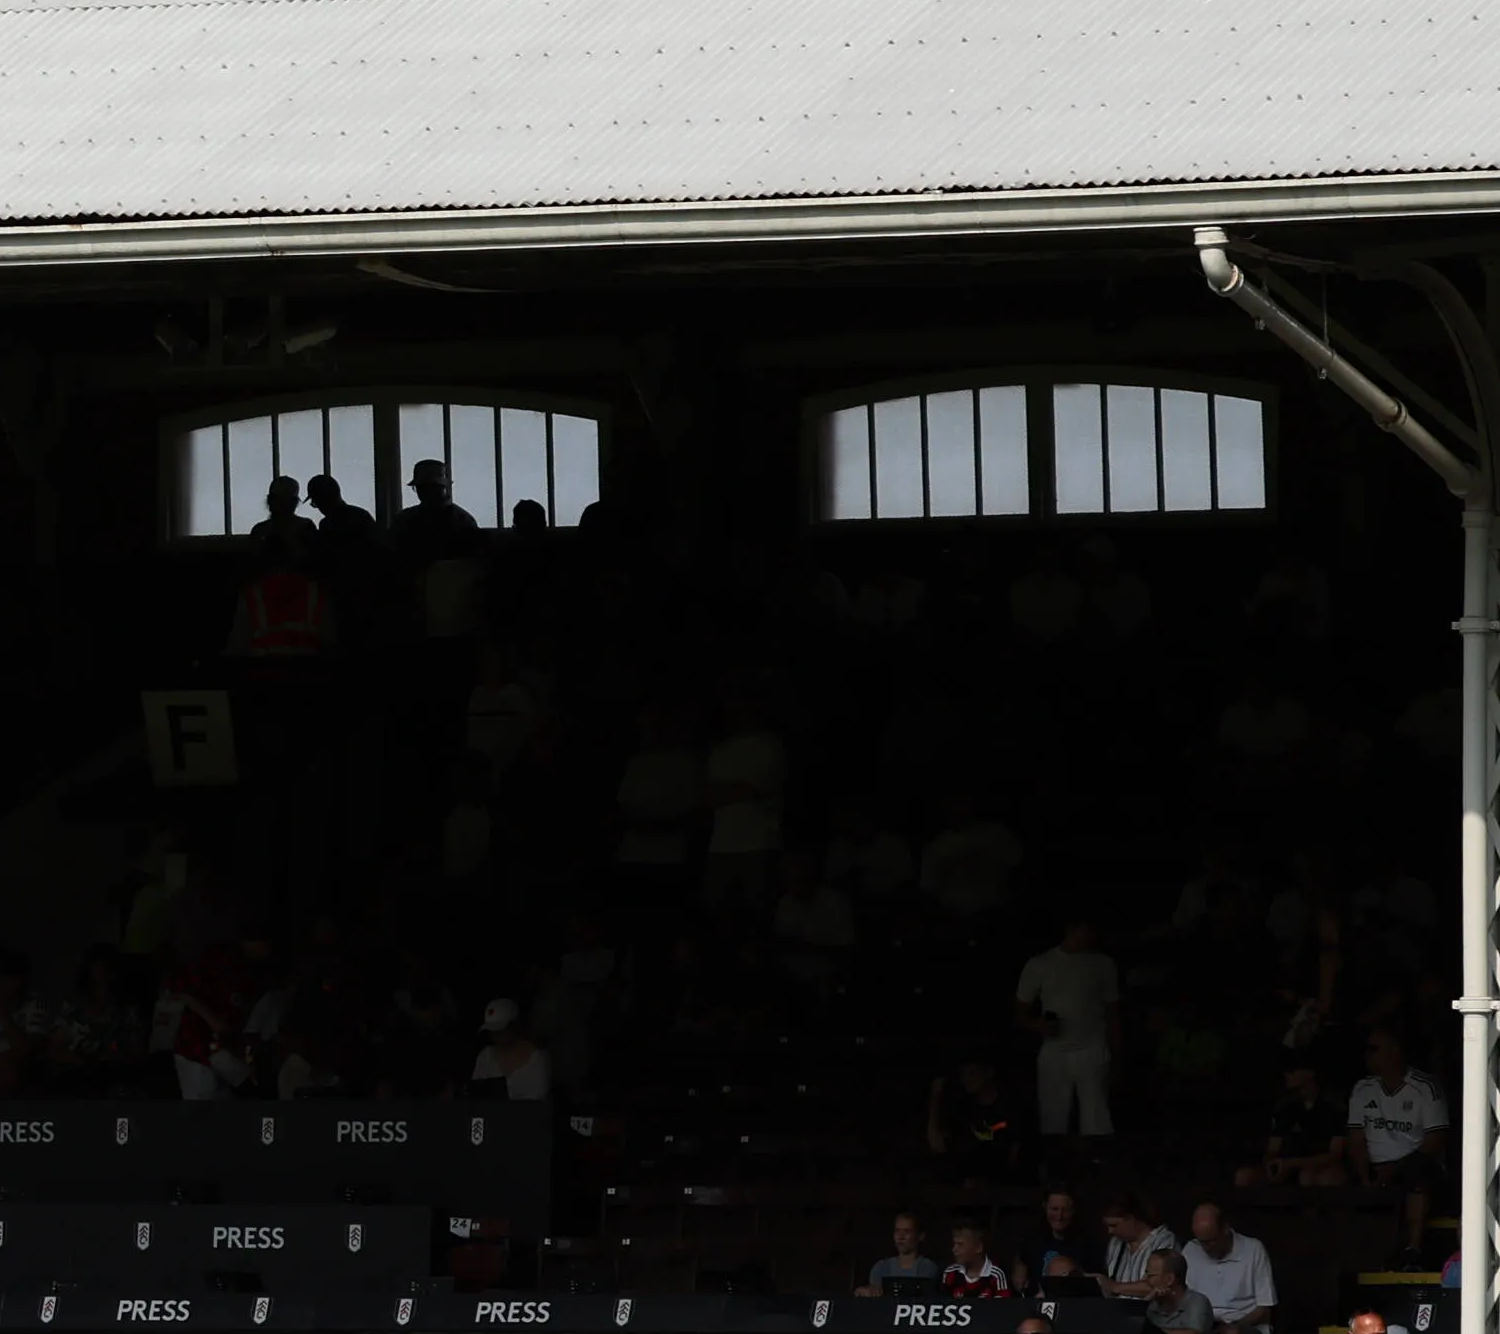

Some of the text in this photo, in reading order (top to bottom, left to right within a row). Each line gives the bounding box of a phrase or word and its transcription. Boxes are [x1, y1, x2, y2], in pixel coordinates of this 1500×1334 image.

[167, 704, 207, 770] F
[337, 1121, 408, 1143] PRESS
[213, 1226, 285, 1249] PRESS
[116, 1299, 191, 1322] PRESS
[475, 1301, 551, 1323] PRESS
[894, 1304, 972, 1327] PRESS
